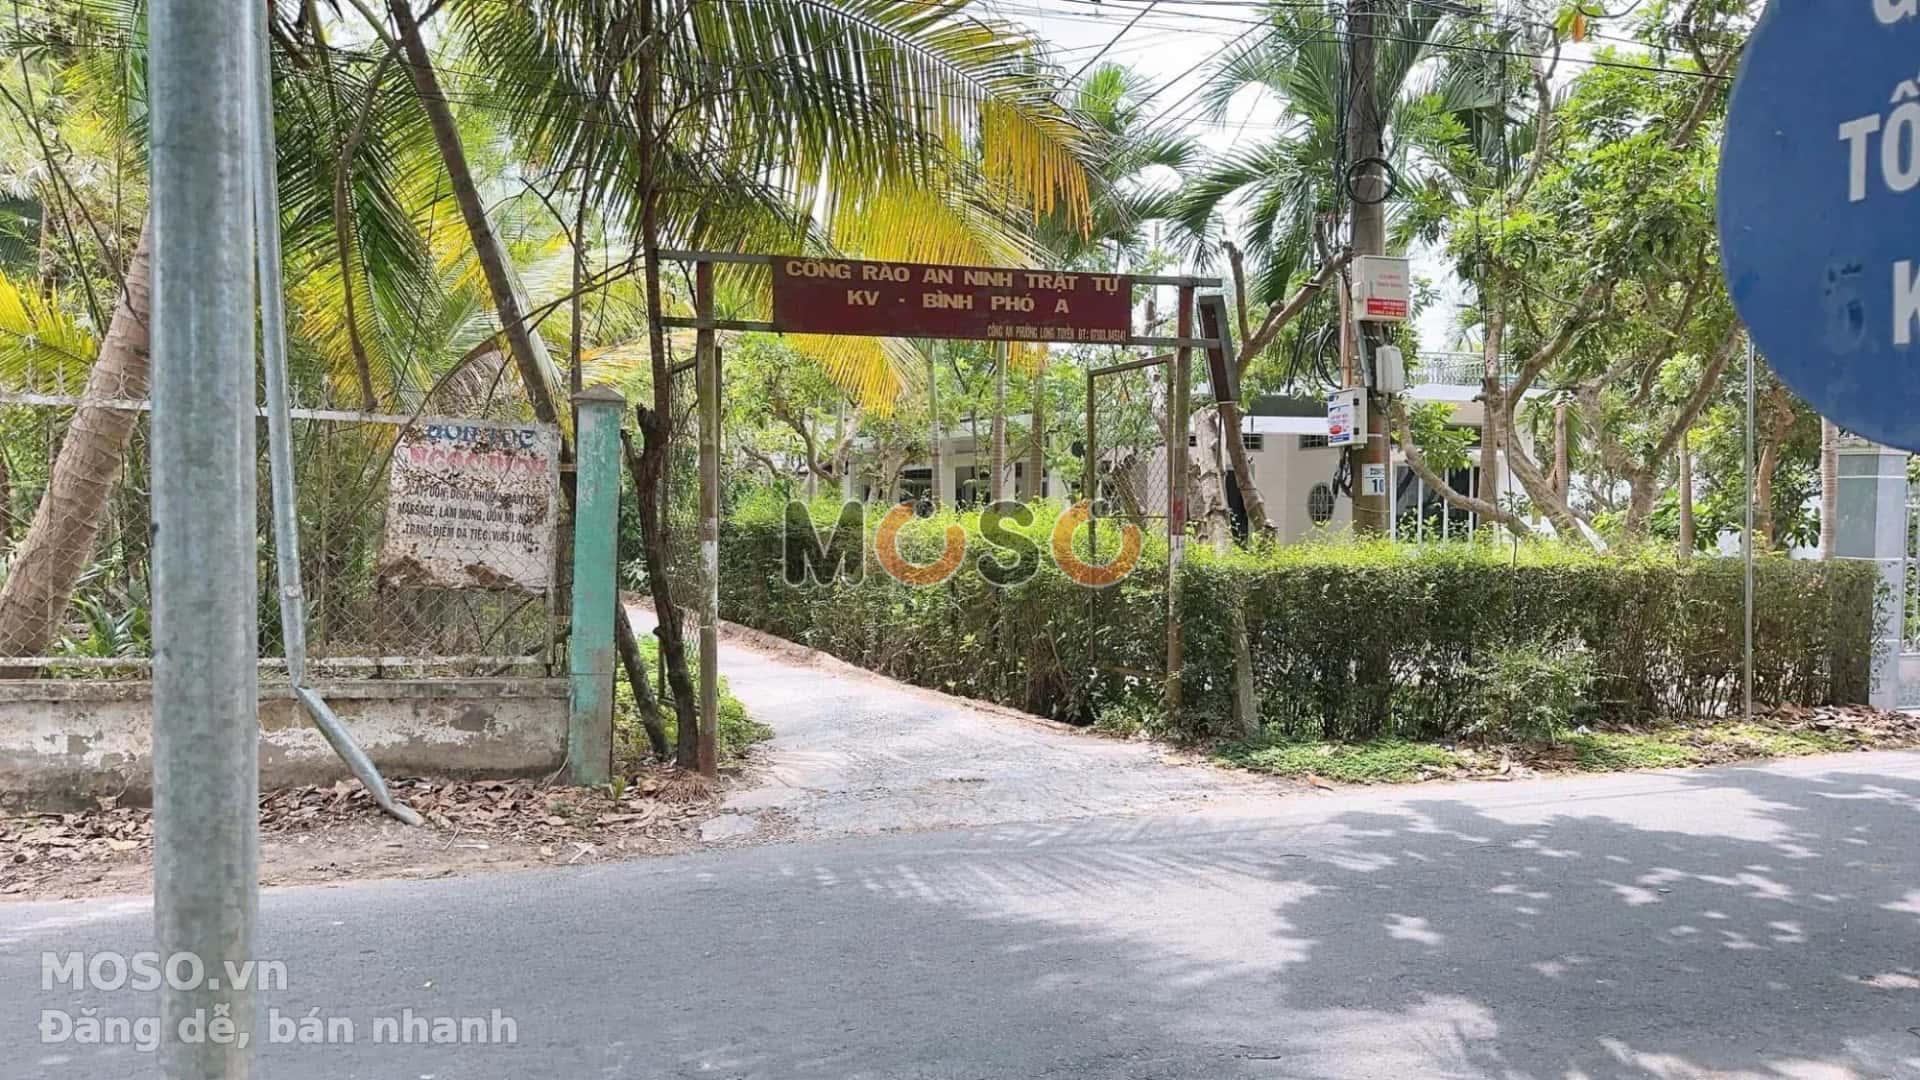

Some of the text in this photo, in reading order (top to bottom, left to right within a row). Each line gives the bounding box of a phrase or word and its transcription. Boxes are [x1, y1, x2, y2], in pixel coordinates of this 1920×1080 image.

[862, 263, 911, 282] RÀO
[922, 268, 953, 285] AN
[963, 270, 1013, 288] NINH
[1024, 272, 1079, 293] TRẬT
[1091, 275, 1121, 296] TỰ
[847, 290, 880, 306] KV
[922, 289, 973, 310] BÌNH
[990, 292, 1035, 312] PHÓ
[1054, 298, 1070, 314] A
